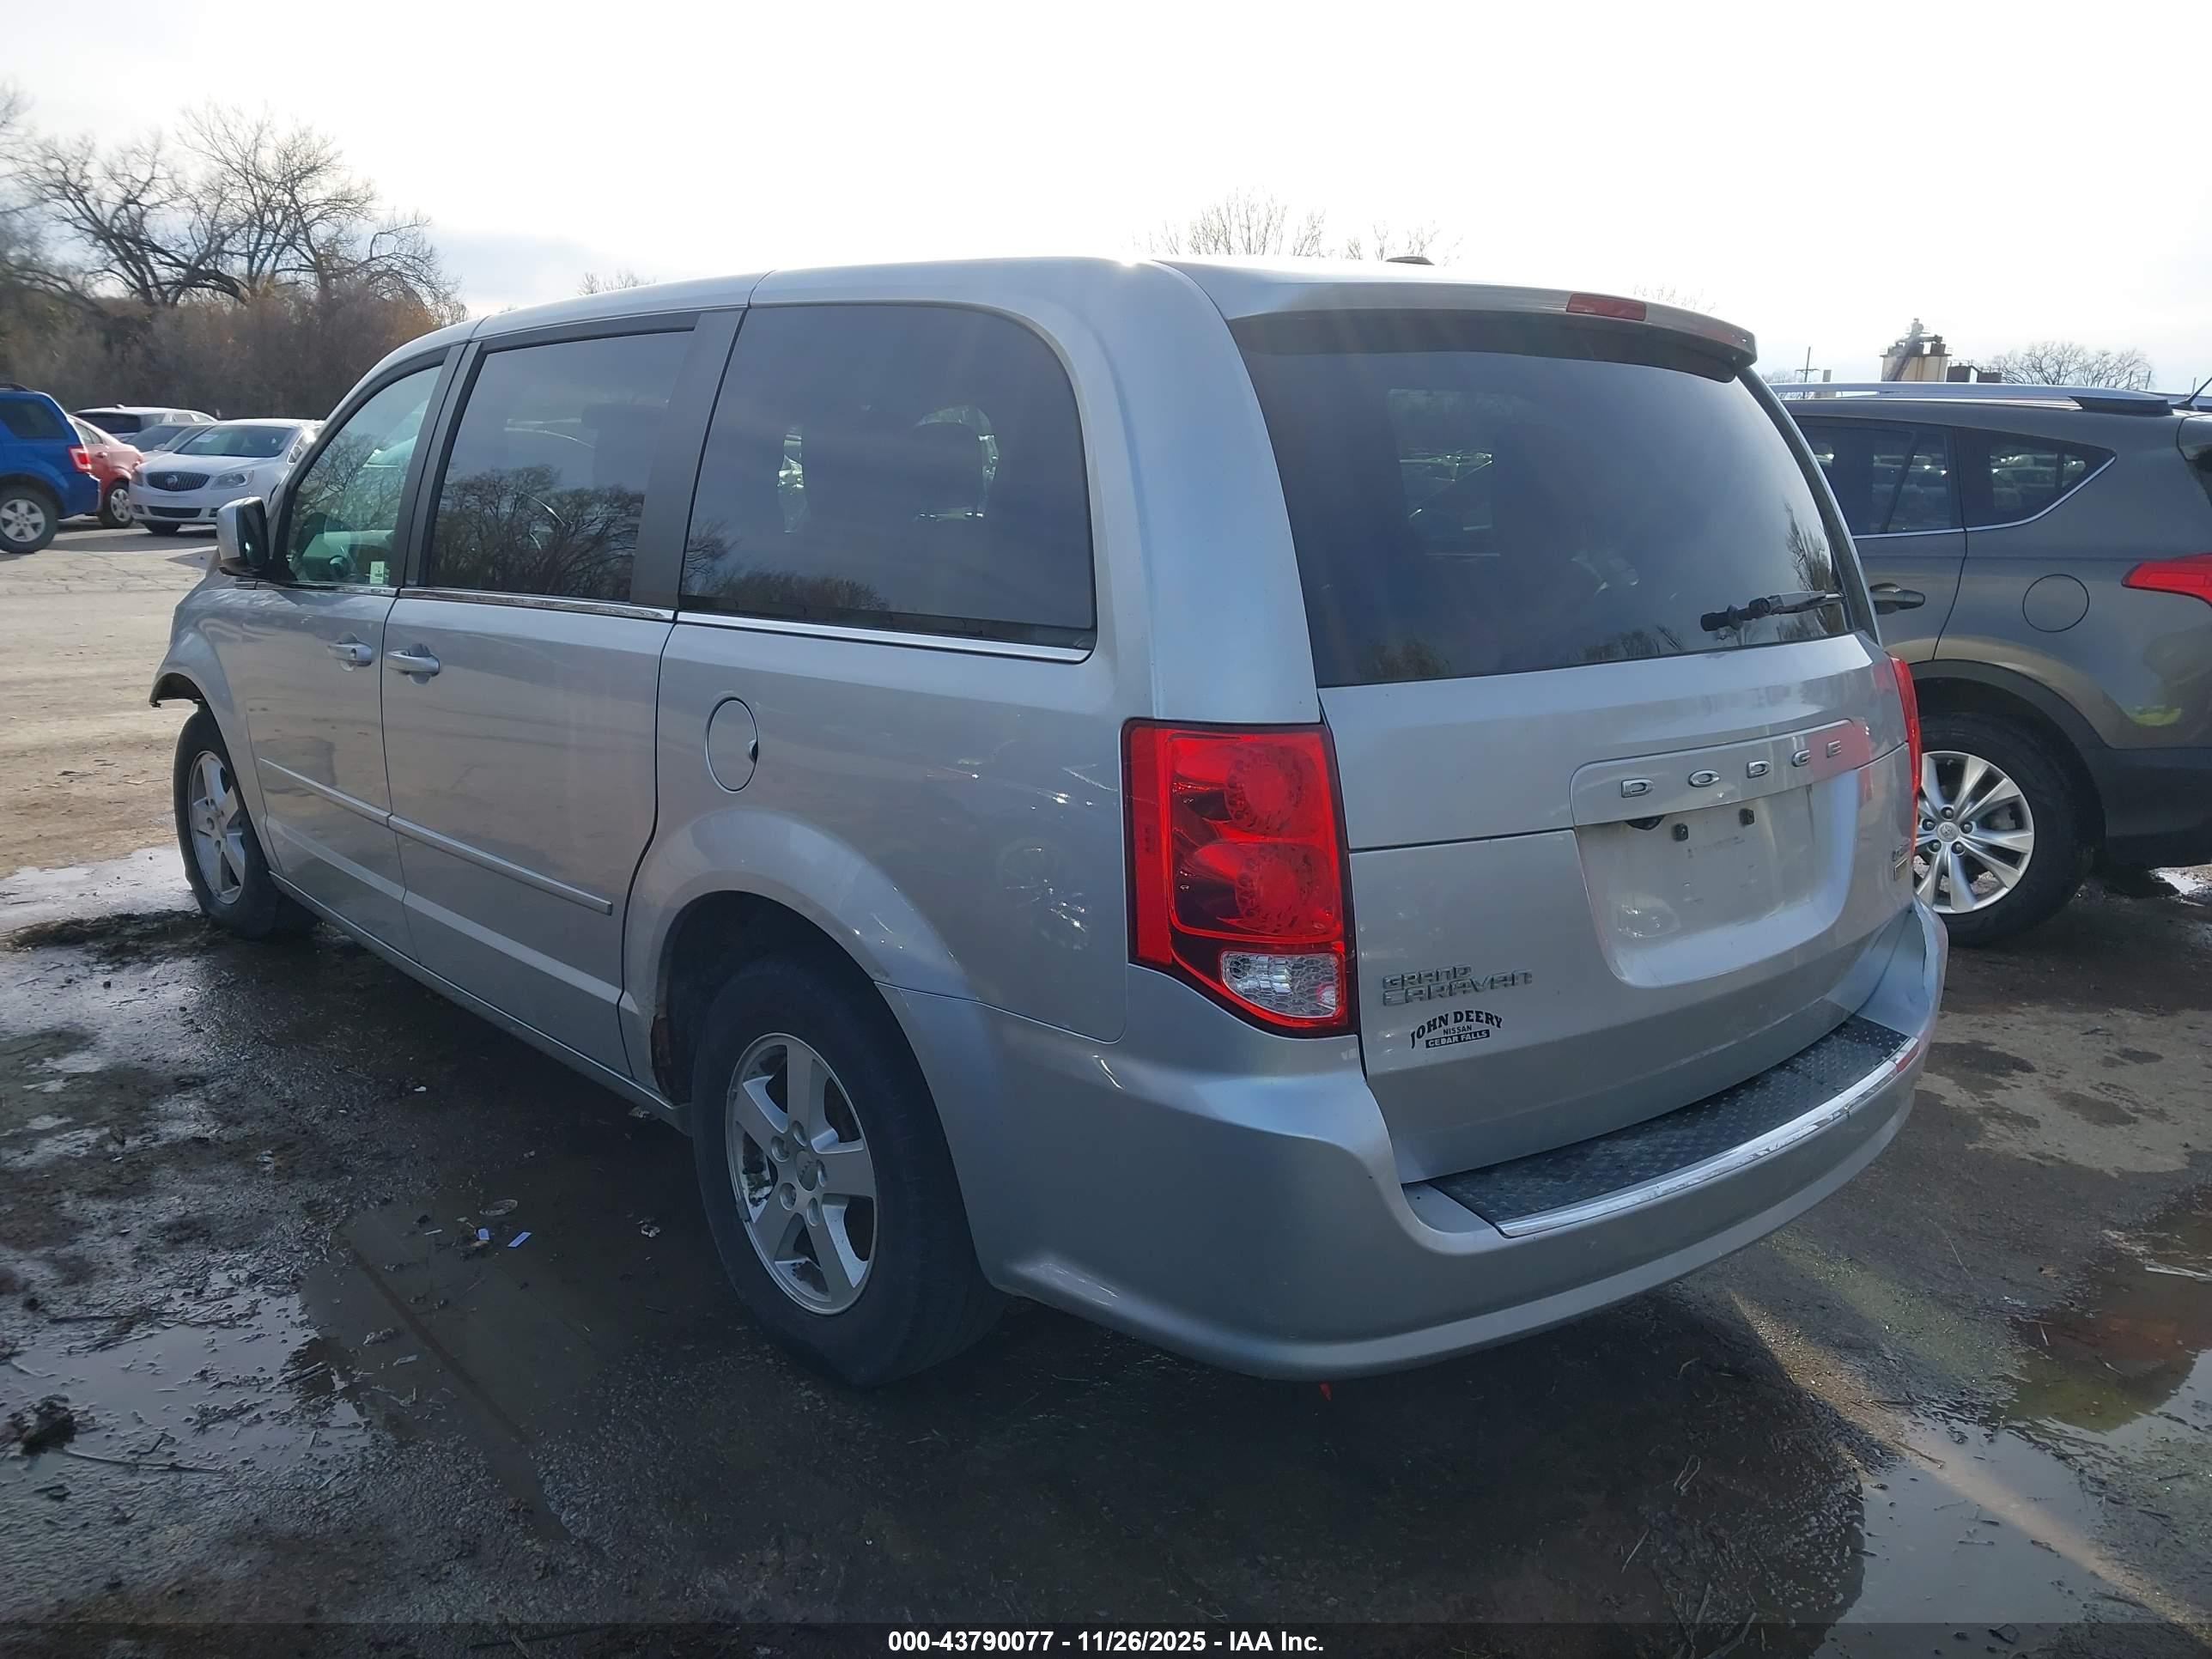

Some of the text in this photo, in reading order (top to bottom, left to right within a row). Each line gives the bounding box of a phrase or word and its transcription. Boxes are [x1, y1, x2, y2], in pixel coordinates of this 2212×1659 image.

[1620, 740, 1842, 799] DODGE
[1382, 964, 1472, 989] GRAND
[1382, 969, 1533, 1006] CARAVAN
[1410, 1010, 1503, 1049] JOHN DEERY
[1428, 1030, 1488, 1048] CEDAR FALLS
[1443, 1024, 1473, 1036] NISSAN
